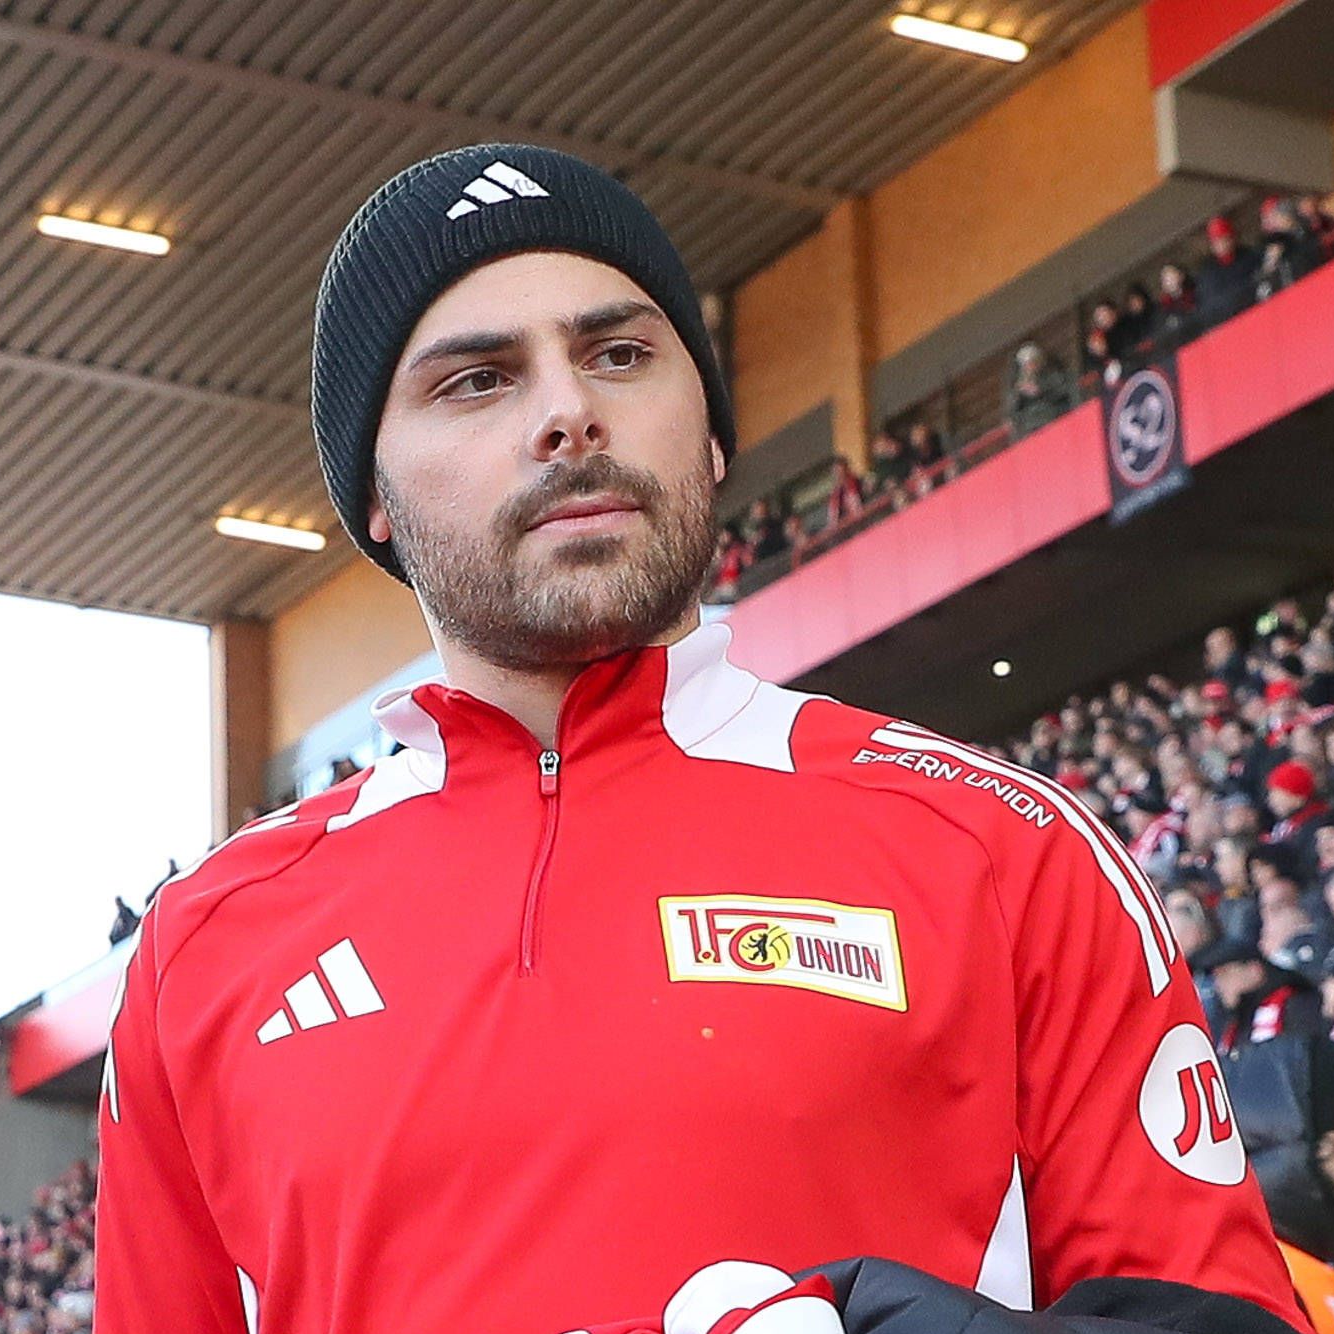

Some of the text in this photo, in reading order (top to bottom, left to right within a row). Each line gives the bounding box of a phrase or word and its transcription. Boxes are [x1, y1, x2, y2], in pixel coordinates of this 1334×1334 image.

[963, 771, 1056, 829] UNION
[795, 934, 883, 983] UNION
[1173, 1059, 1233, 1158] JD
